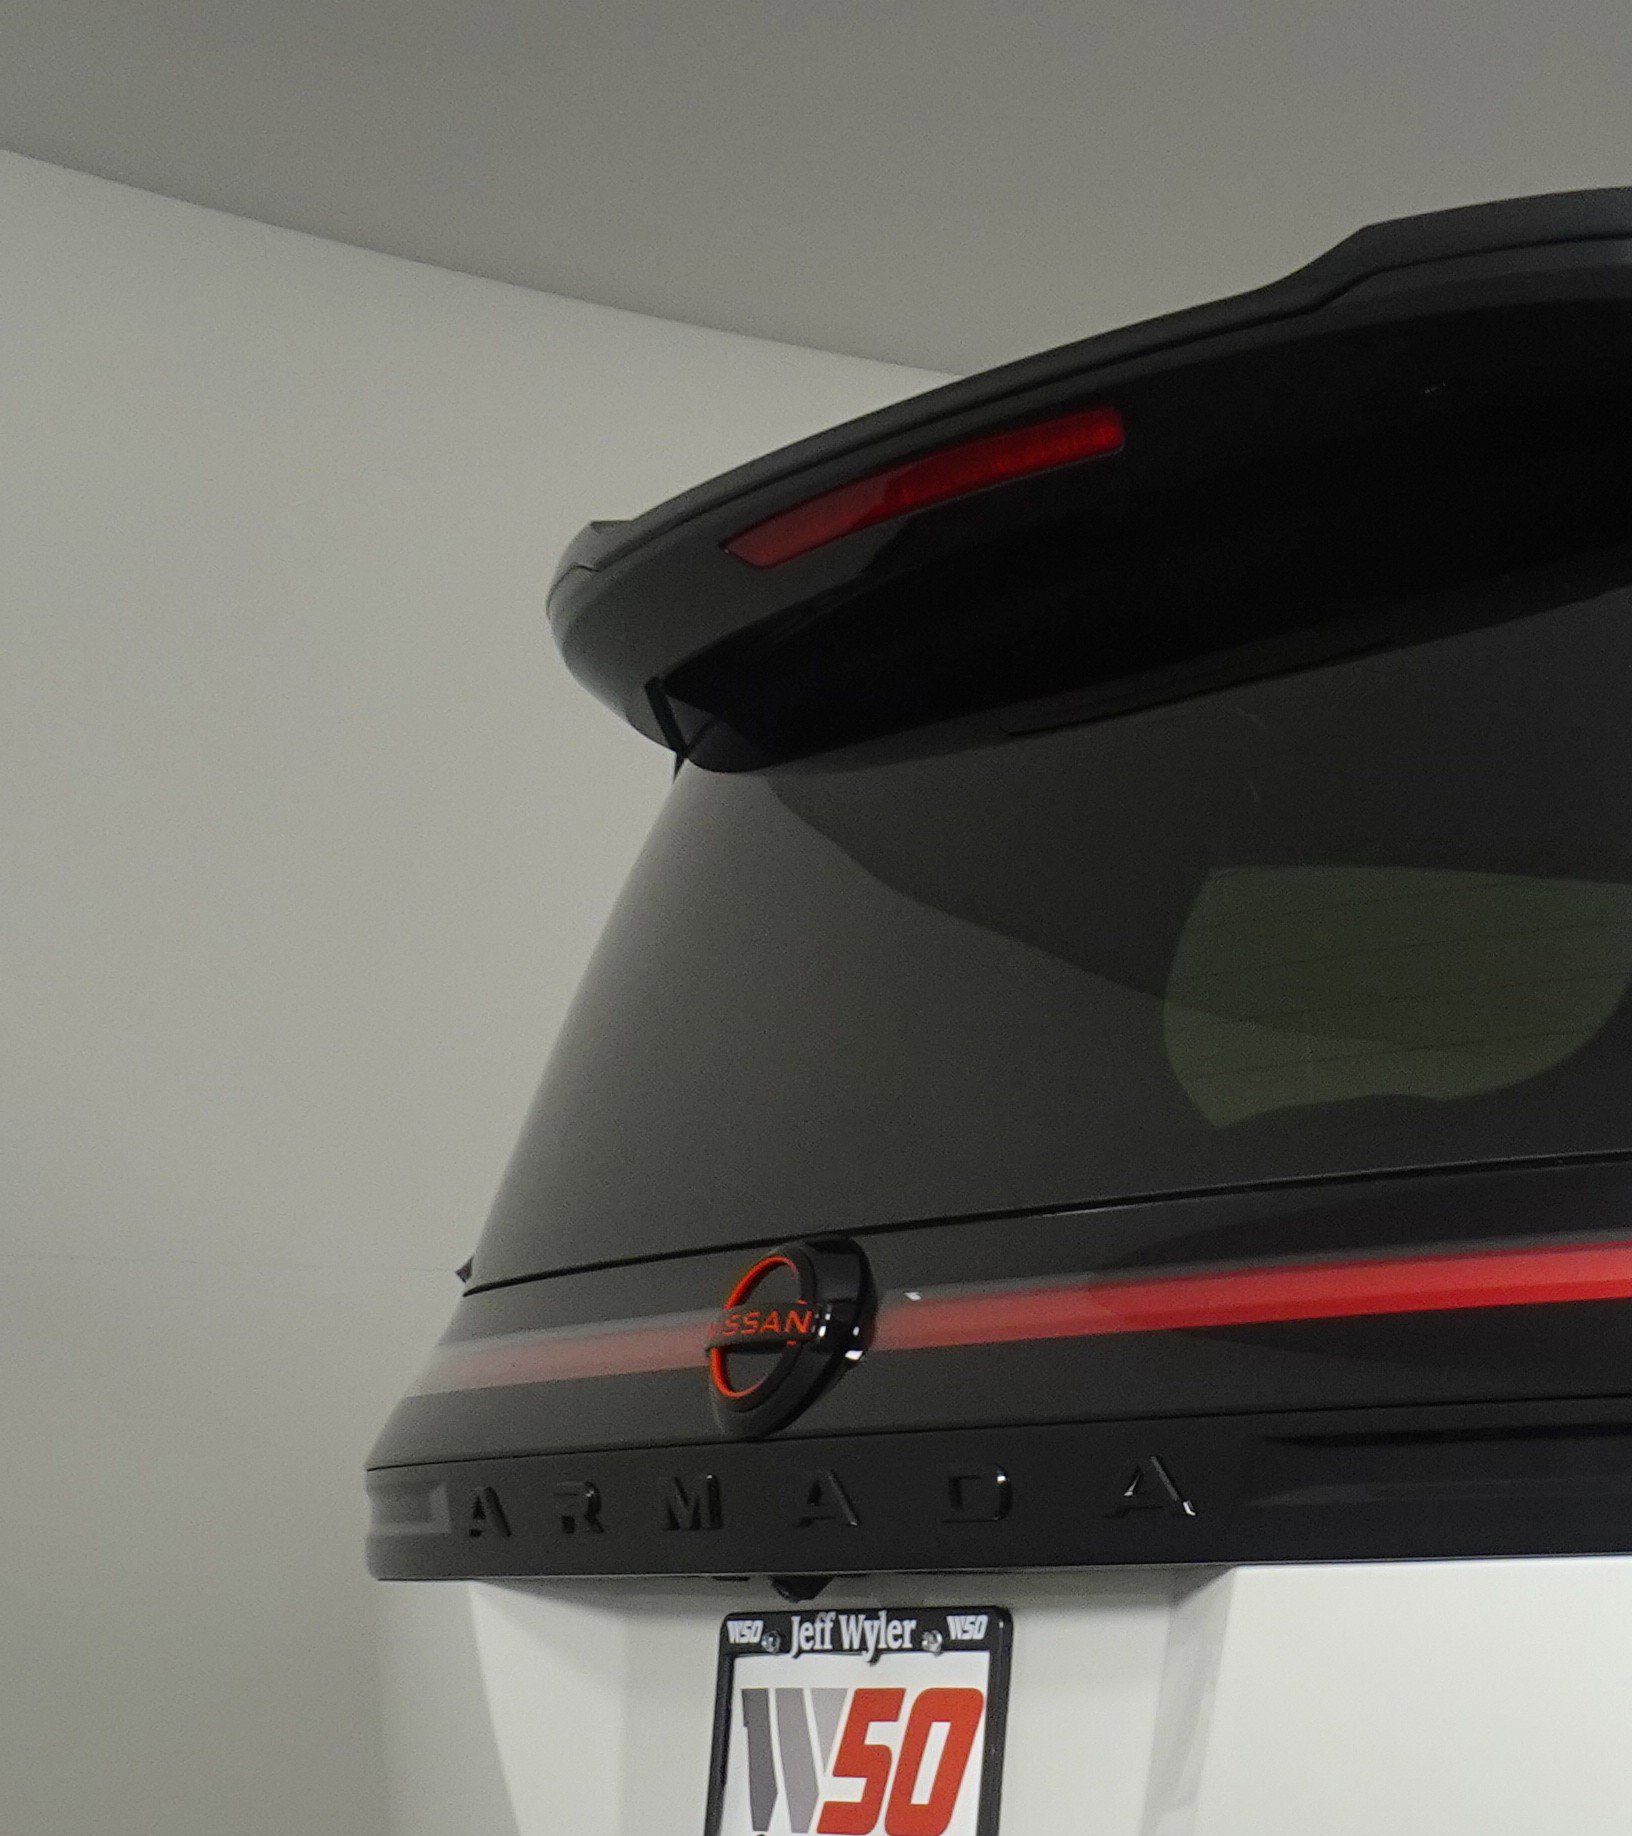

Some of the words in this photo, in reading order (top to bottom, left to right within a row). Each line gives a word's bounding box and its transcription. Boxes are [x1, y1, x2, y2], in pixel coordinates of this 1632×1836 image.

[706, 1309, 814, 1341] SSAN
[466, 1453, 1199, 1540] ARMADA
[726, 1619, 765, 1645] W50
[789, 1610, 837, 1659] Jeff
[838, 1609, 917, 1663] Wyler
[946, 1614, 989, 1641] W50
